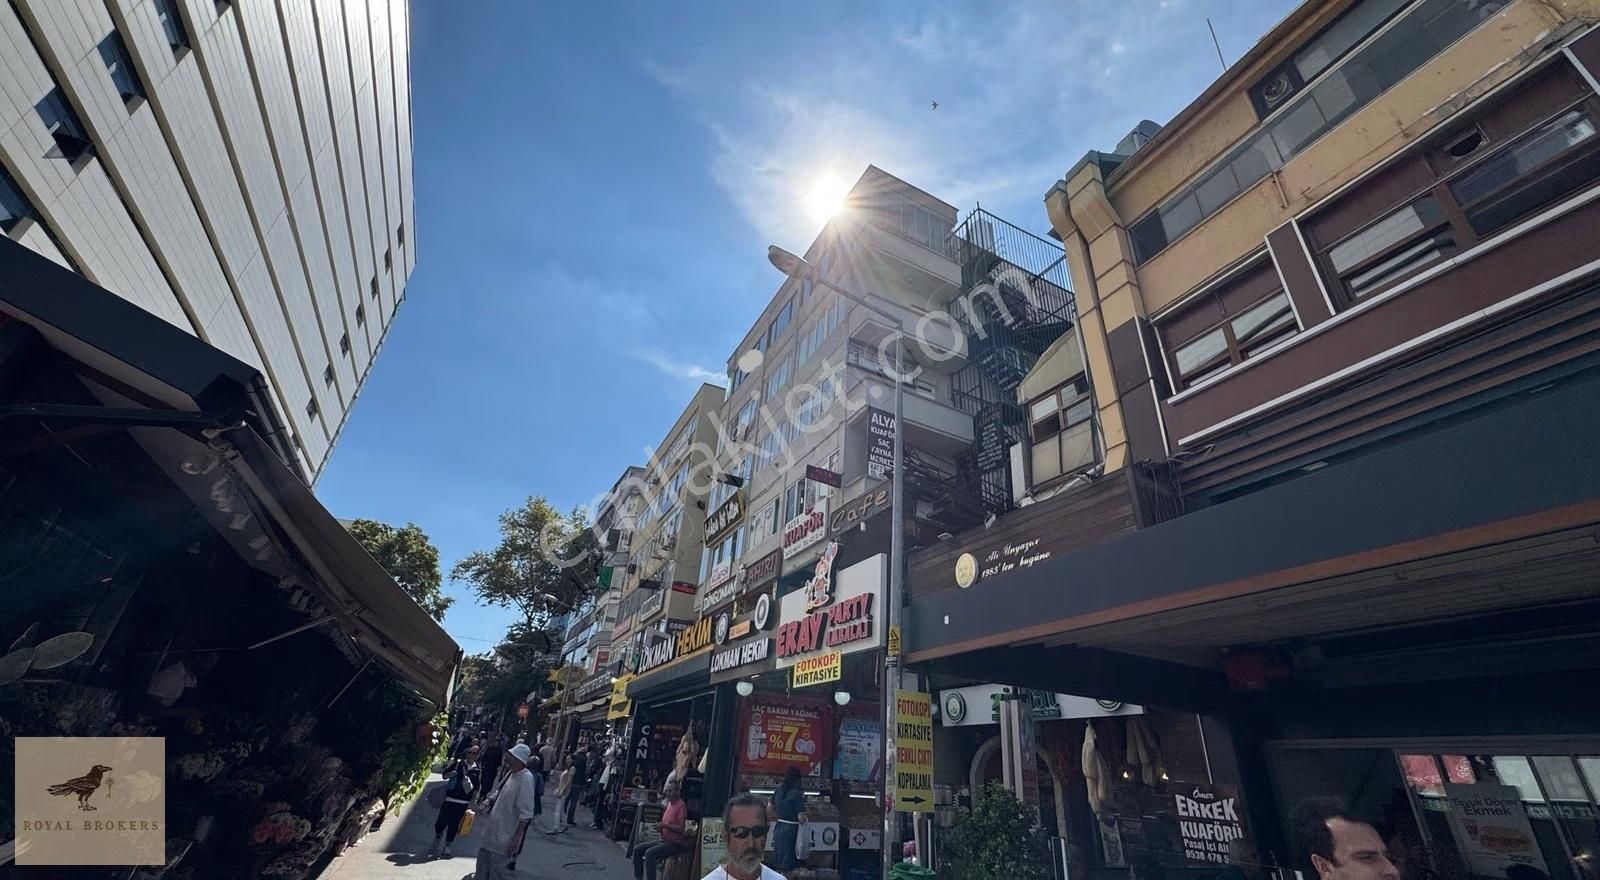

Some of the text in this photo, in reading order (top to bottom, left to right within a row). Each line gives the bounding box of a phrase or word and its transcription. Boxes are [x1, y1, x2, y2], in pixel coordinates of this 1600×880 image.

[871, 412, 896, 429] ALYA
[870, 447, 896, 459] KAYNA
[877, 438, 891, 449] SAÇ
[831, 490, 888, 532] Cafe
[783, 511, 824, 548] KUAFÖR
[828, 593, 872, 626] PARTY
[776, 612, 826, 657] ERAY
[638, 634, 676, 674] LOKMAN
[710, 647, 740, 673] LOKMAN
[767, 706, 790, 715] BAKIM
[897, 721, 931, 741] KIRTASİYE
[897, 772, 931, 791] KOPYALAMA
[1175, 794, 1239, 821] ERKEK
[1463, 804, 1513, 816] Ekmek
[703, 833, 718, 845] Saf
[1185, 849, 1206, 861] 0538
